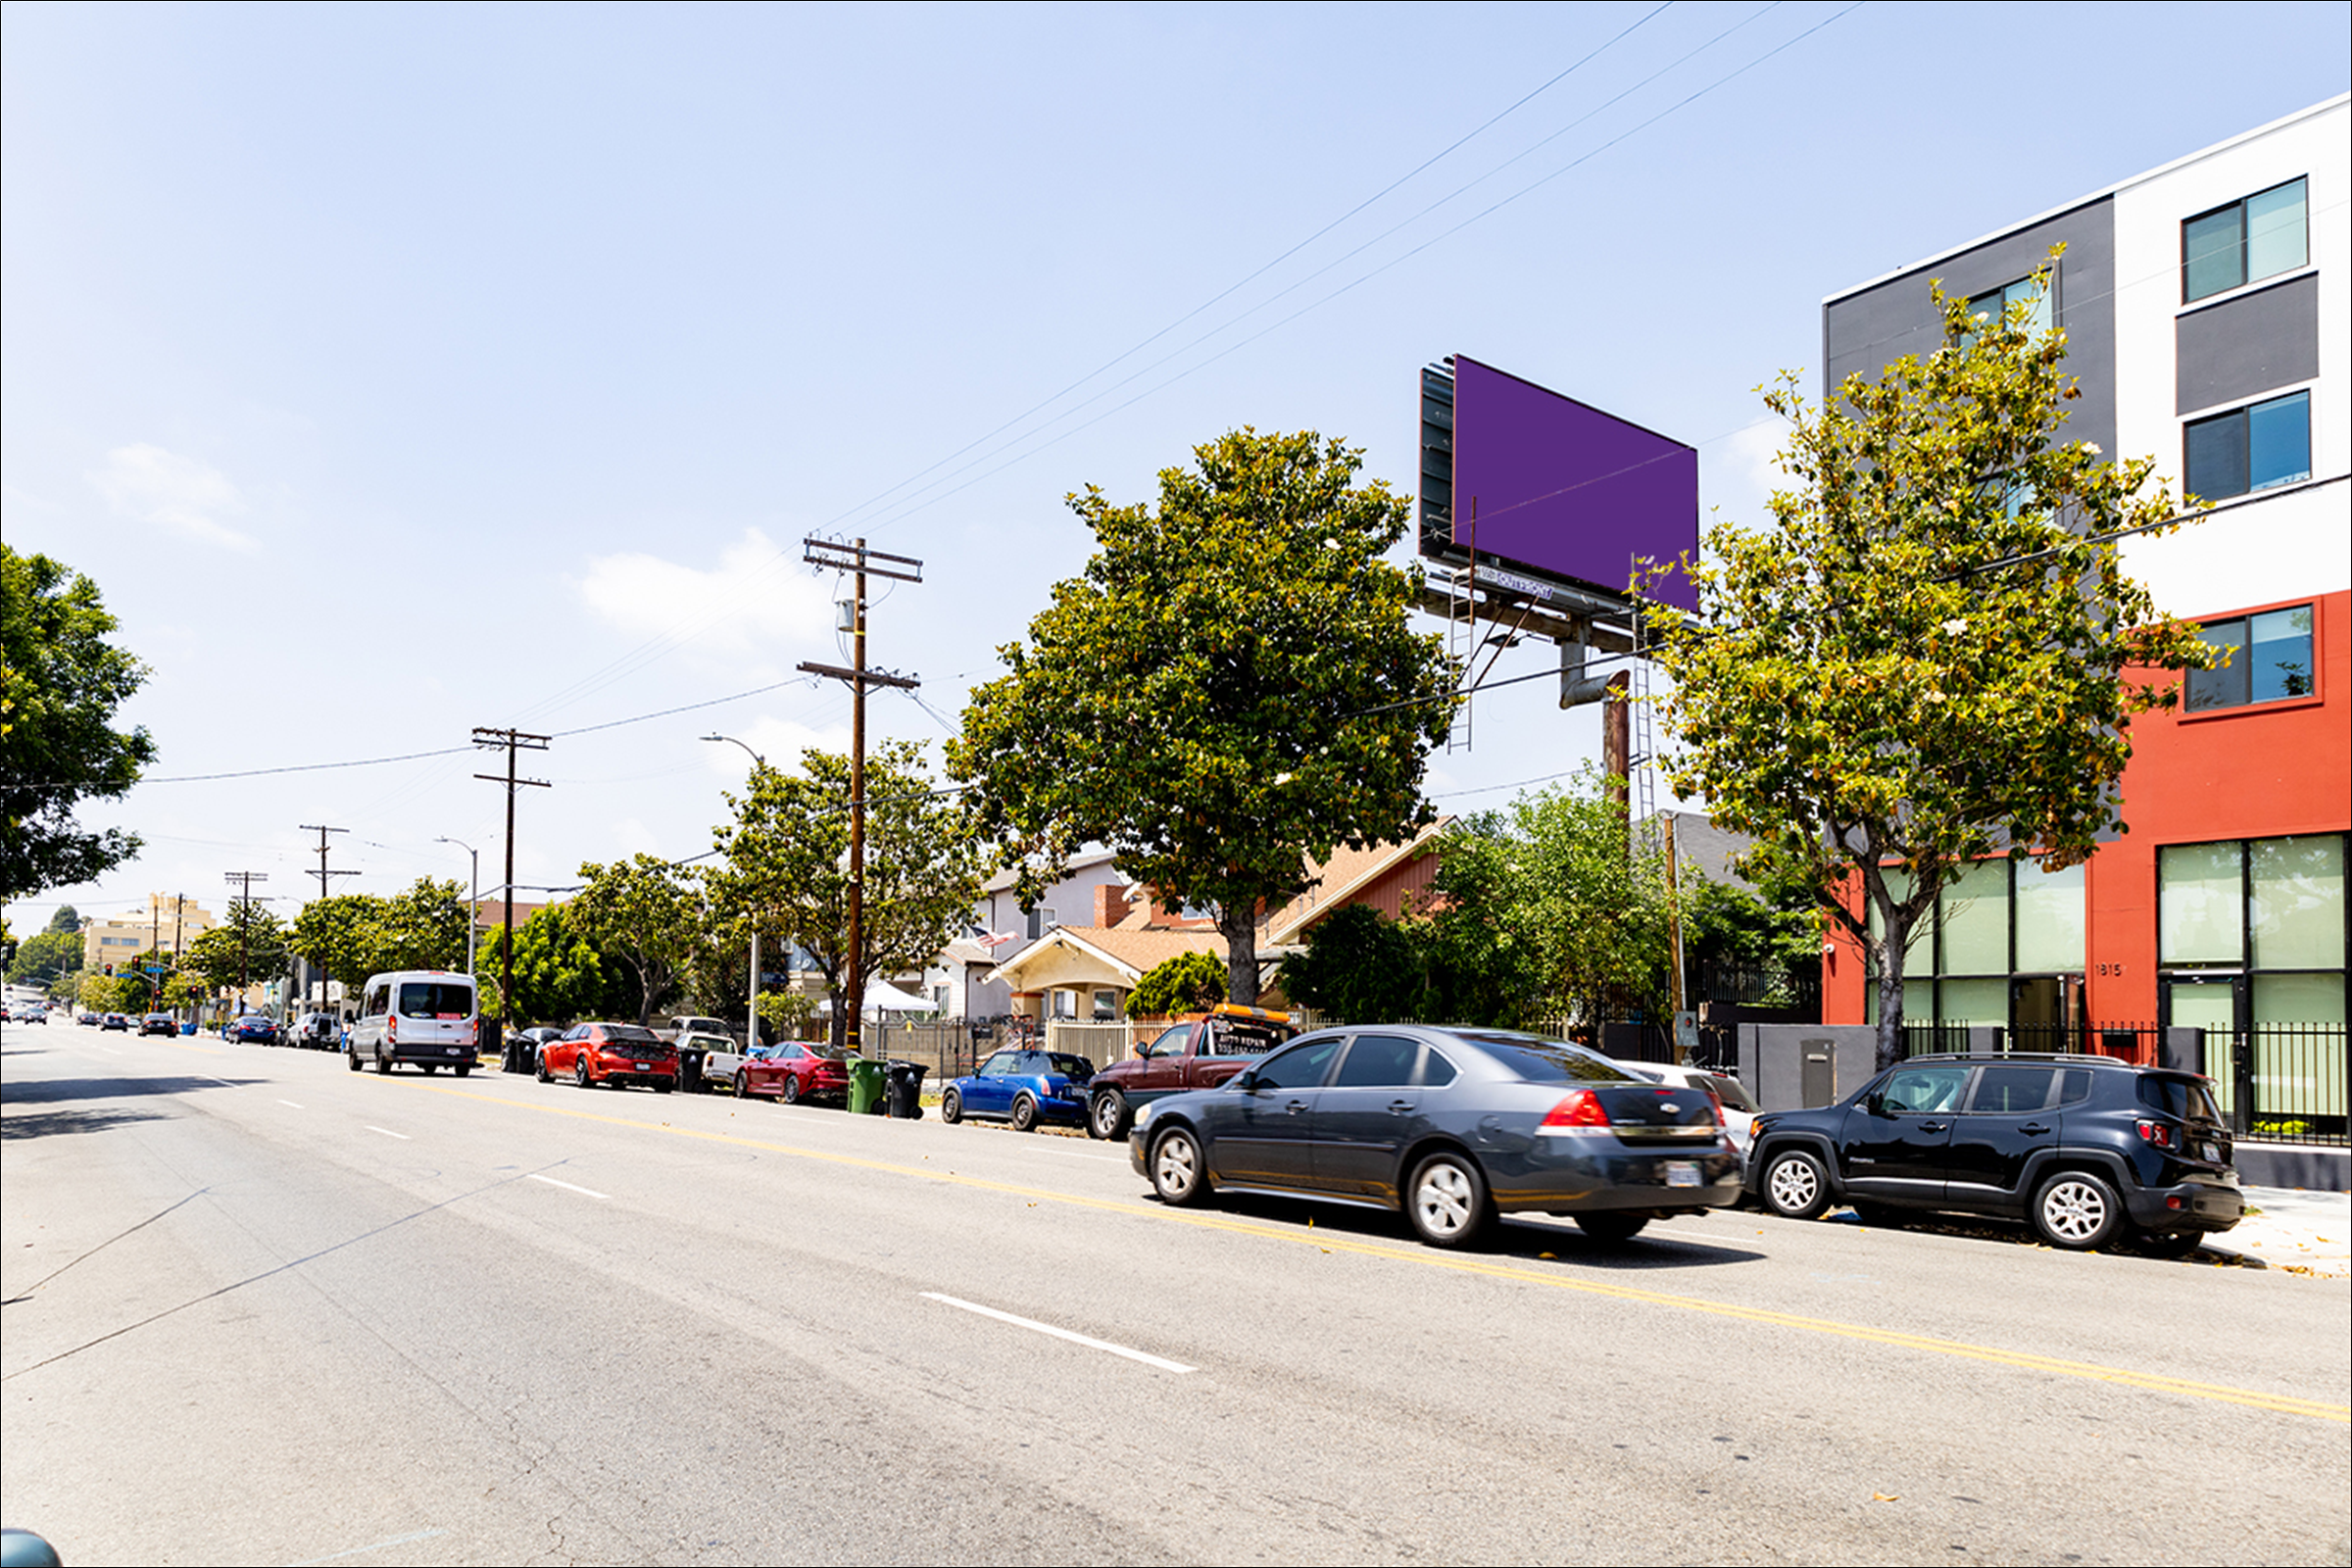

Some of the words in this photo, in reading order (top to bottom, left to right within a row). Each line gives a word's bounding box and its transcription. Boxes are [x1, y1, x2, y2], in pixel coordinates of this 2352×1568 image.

[2095, 963, 2122, 977] 1815
[1219, 1034, 1240, 1044] AUTO
[1241, 1036, 1267, 1048] REPAIR
